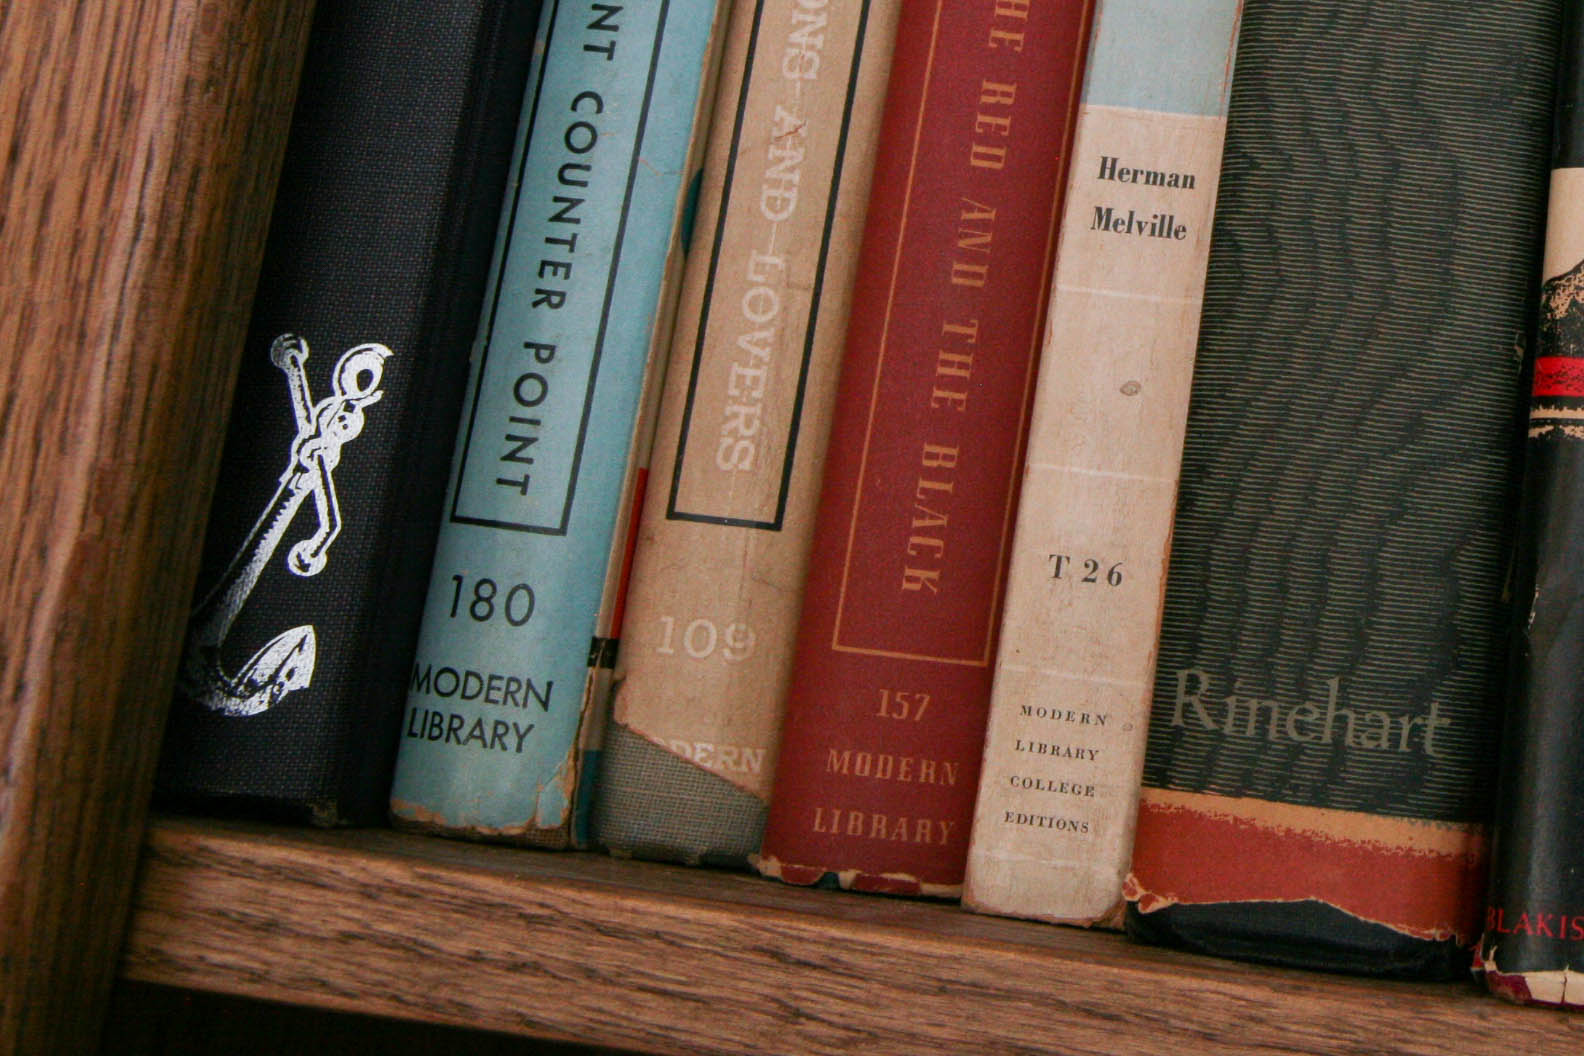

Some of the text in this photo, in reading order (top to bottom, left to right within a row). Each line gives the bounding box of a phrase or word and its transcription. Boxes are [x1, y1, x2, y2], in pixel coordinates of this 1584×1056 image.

[969, 79, 1018, 171] RED
[759, 105, 809, 222] AND
[1096, 156, 1197, 190] Herman
[531, 90, 604, 310] COUNTER
[1090, 206, 1188, 241] Melville
[950, 196, 998, 289] AND
[715, 249, 786, 473] LOVERS
[930, 318, 980, 413] THE
[496, 341, 556, 496] POINT
[901, 442, 960, 595] BLACK
[450, 574, 535, 627] 180
[655, 615, 757, 662] 109
[409, 663, 553, 713] MODERN
[876, 688, 931, 722] 157
[407, 707, 534, 754] LIBRARY
[1020, 704, 1109, 728] MODERN
[1171, 667, 1452, 758] Rinehart
[656, 737, 769, 775] DERN
[825, 748, 961, 787] MODERN
[1015, 740, 1100, 763] LIBRARY
[1009, 775, 1096, 798] COLLEGE
[812, 807, 956, 846] LIBRARY
[1003, 811, 1090, 834] EDITIONS
